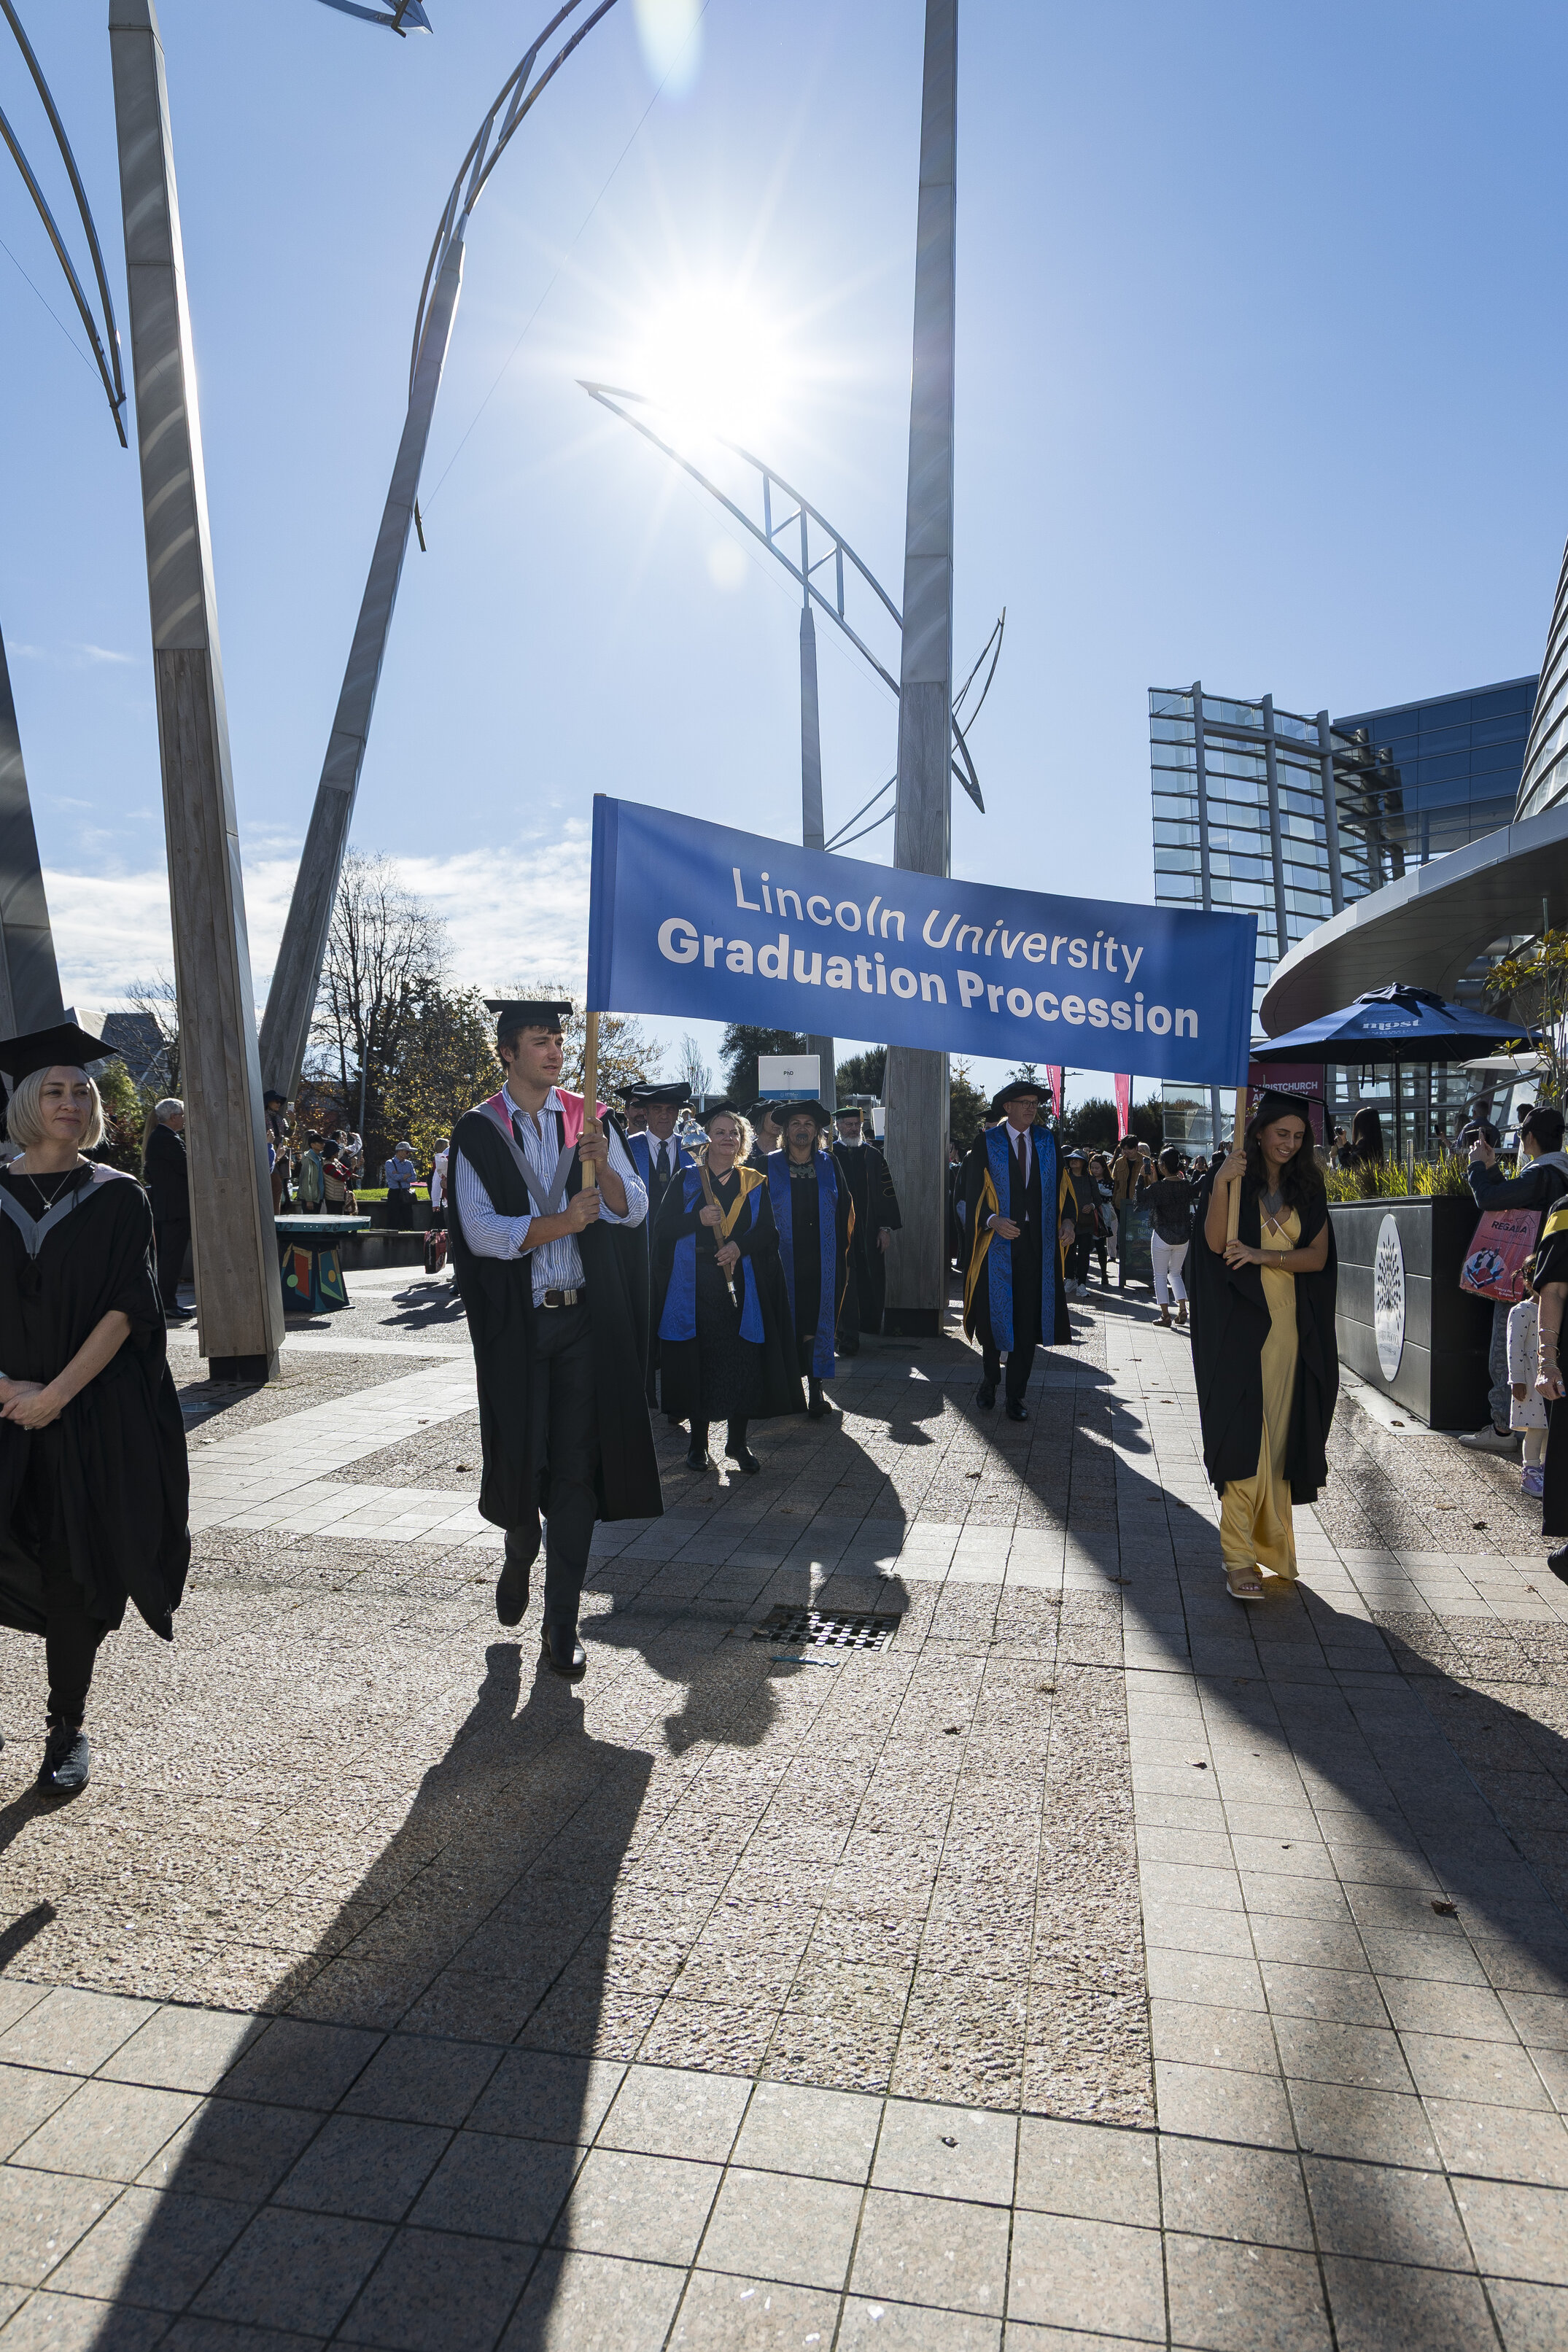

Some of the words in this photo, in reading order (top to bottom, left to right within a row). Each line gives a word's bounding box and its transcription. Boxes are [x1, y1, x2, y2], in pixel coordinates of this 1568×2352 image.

[657, 917, 947, 1004] Graduation
[957, 969, 1198, 1038] Procession
[732, 867, 906, 943] Lincoln
[922, 909, 1144, 983] University
[1253, 1081, 1318, 1092] CRISTCHURCH
